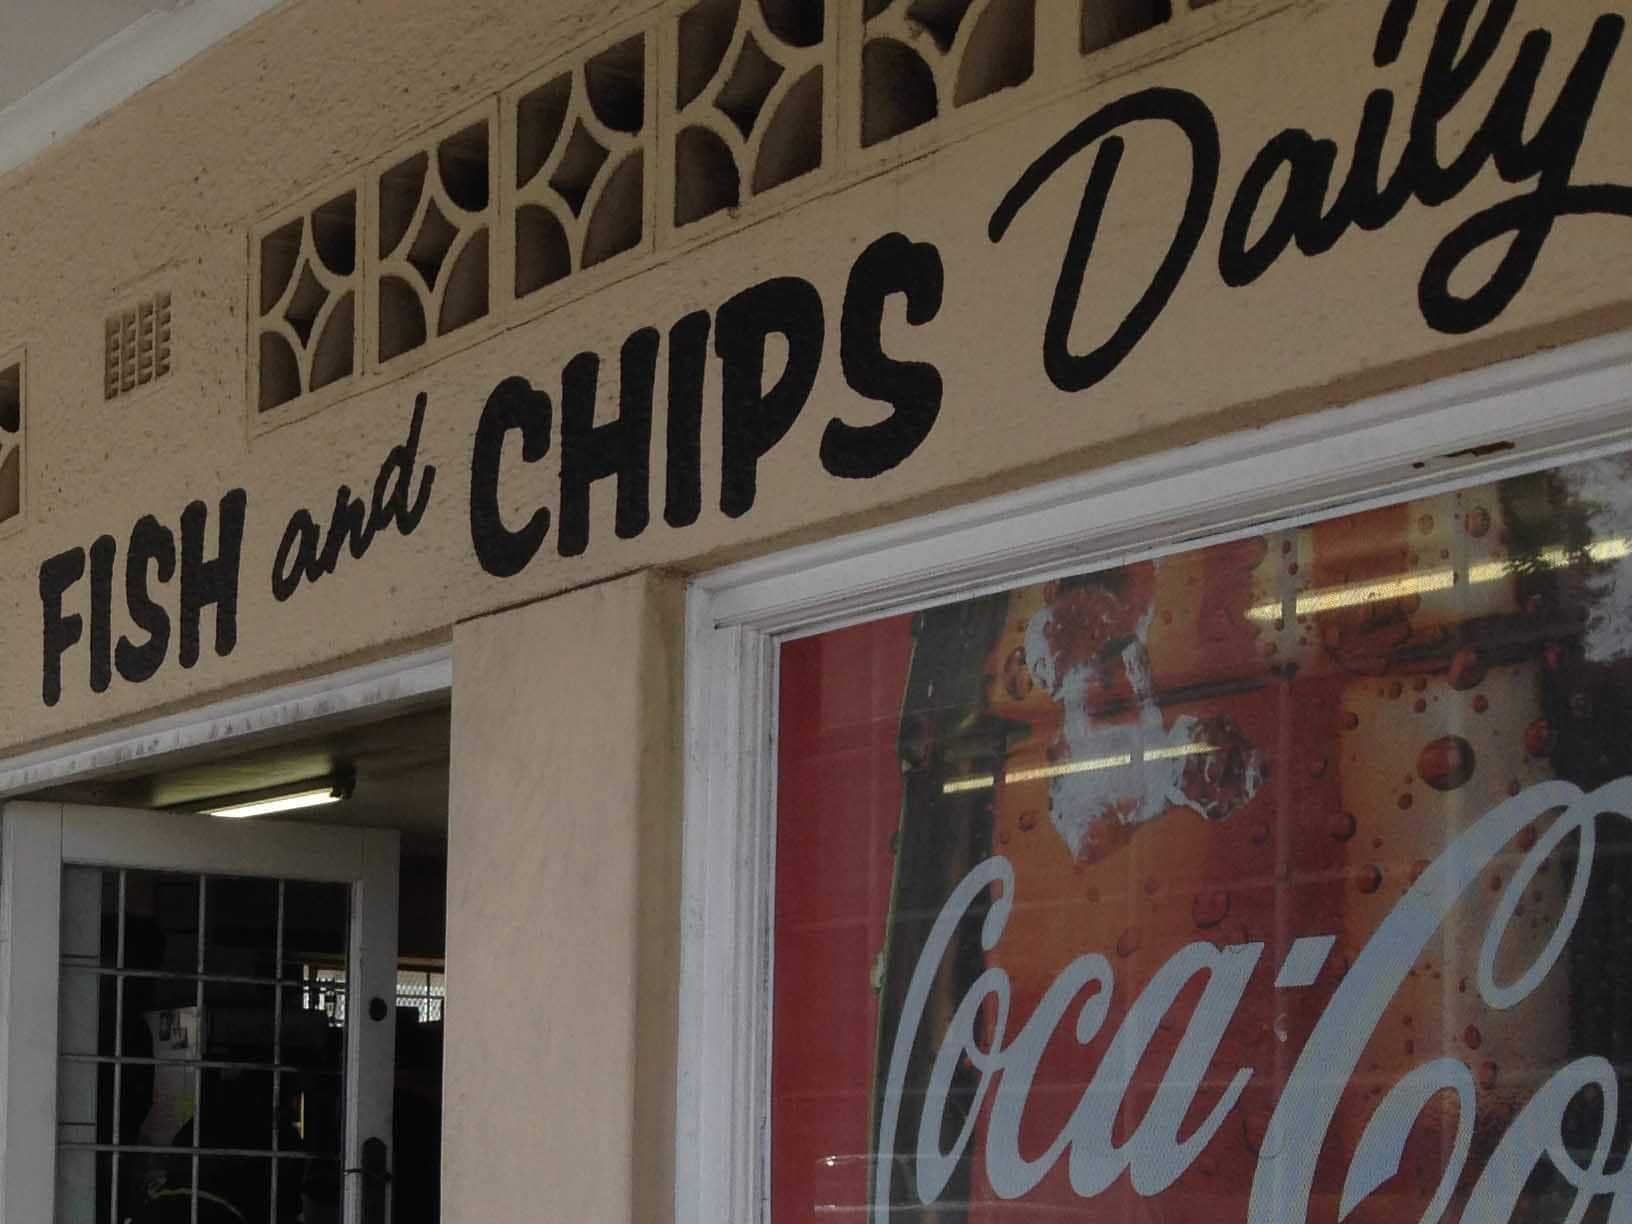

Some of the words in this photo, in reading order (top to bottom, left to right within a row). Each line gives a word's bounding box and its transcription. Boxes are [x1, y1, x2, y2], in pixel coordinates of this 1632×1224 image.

[39, 487, 247, 707] FISH
[272, 391, 435, 601] and
[470, 232, 944, 578] CHIPS
[988, 0, 1632, 392] Daily
